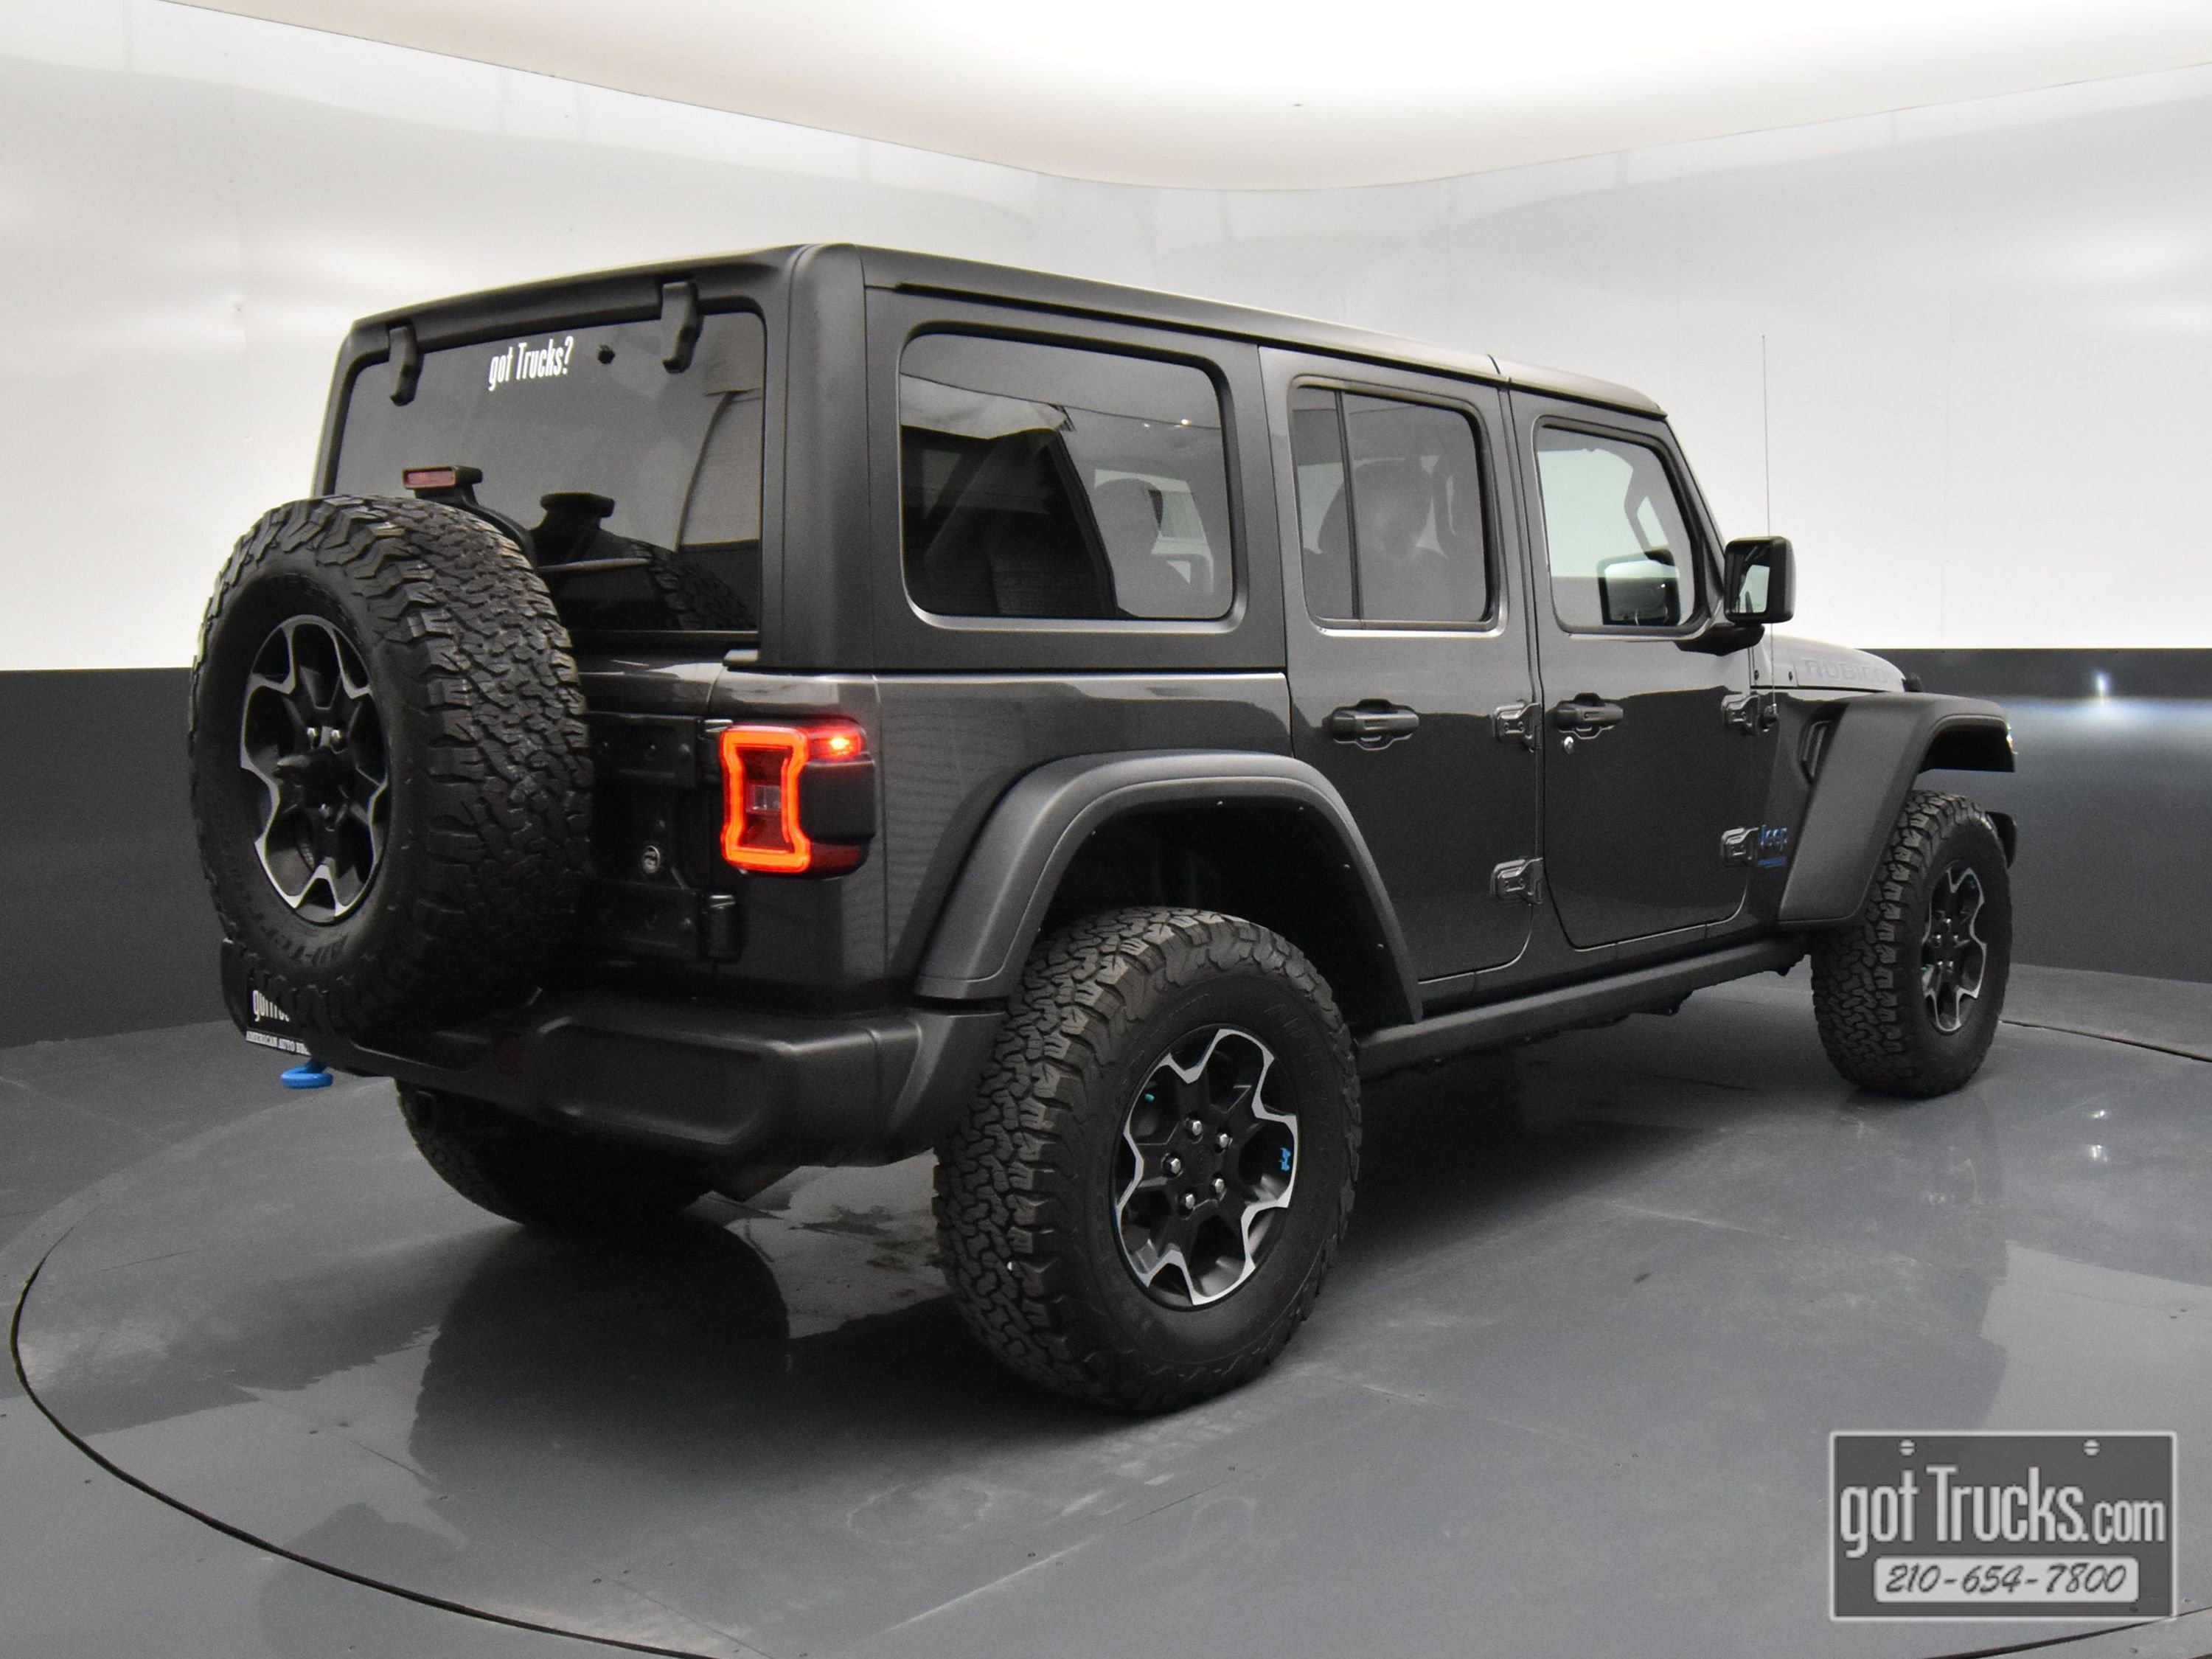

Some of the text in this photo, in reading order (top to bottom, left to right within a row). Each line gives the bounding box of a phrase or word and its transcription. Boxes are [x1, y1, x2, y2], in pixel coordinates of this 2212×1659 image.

[488, 335, 574, 392] got Trucks?
[1803, 658, 1893, 684] RUBICO
